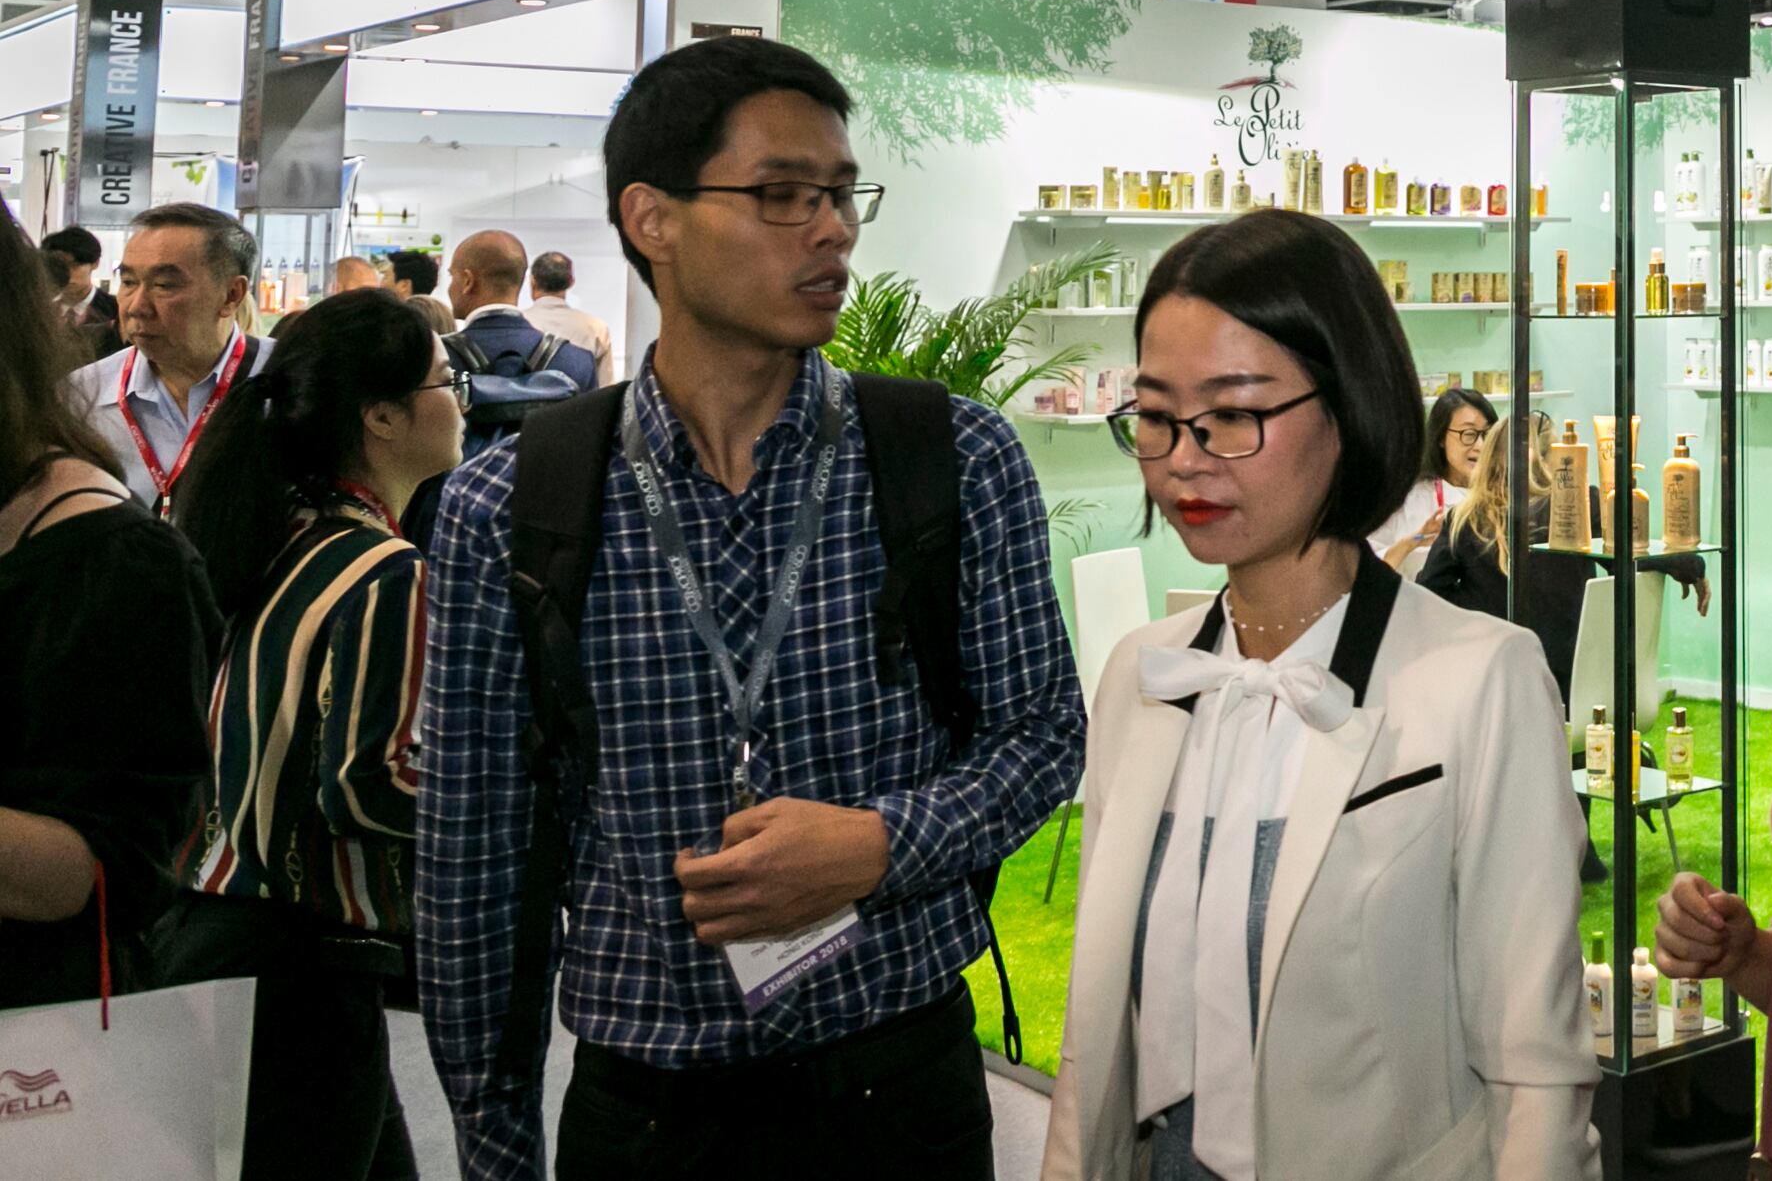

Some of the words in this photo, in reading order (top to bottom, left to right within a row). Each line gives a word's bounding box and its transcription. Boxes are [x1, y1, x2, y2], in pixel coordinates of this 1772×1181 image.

[107, 10, 143, 95] FRANCE
[1213, 95, 1242, 126] Le
[1250, 84, 1304, 130] Petit
[762, 955, 818, 997] EXHIBITOR
[819, 935, 848, 959] 2018
